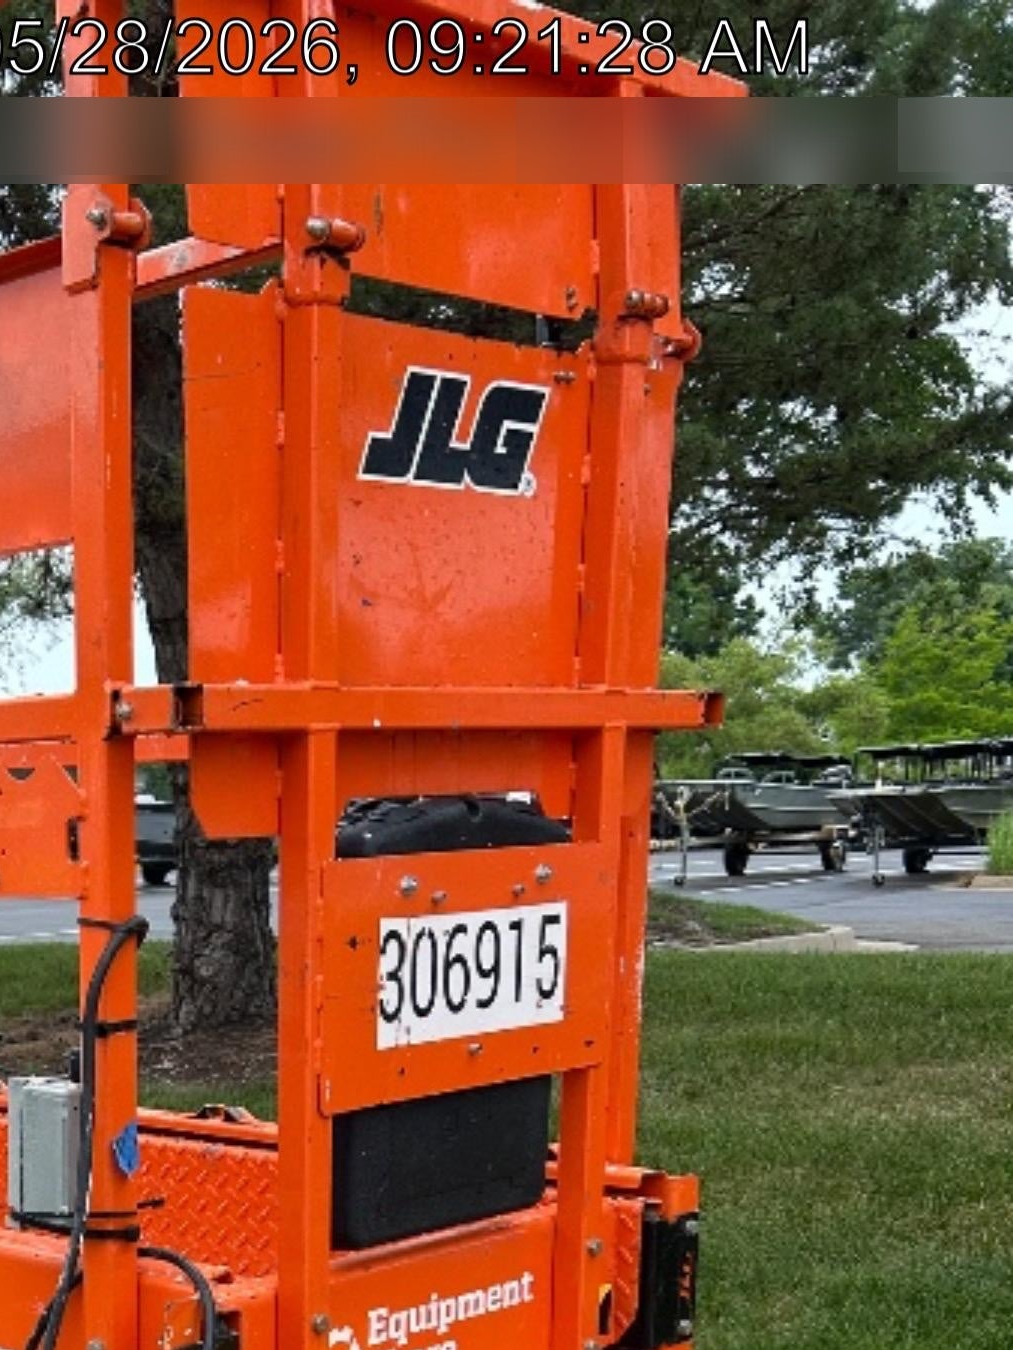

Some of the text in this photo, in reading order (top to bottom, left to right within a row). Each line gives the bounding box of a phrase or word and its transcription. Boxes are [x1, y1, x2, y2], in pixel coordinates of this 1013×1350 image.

[357, 366, 551, 495] JLG
[378, 913, 561, 1023] 306915
[367, 1271, 535, 1346] Equipment
